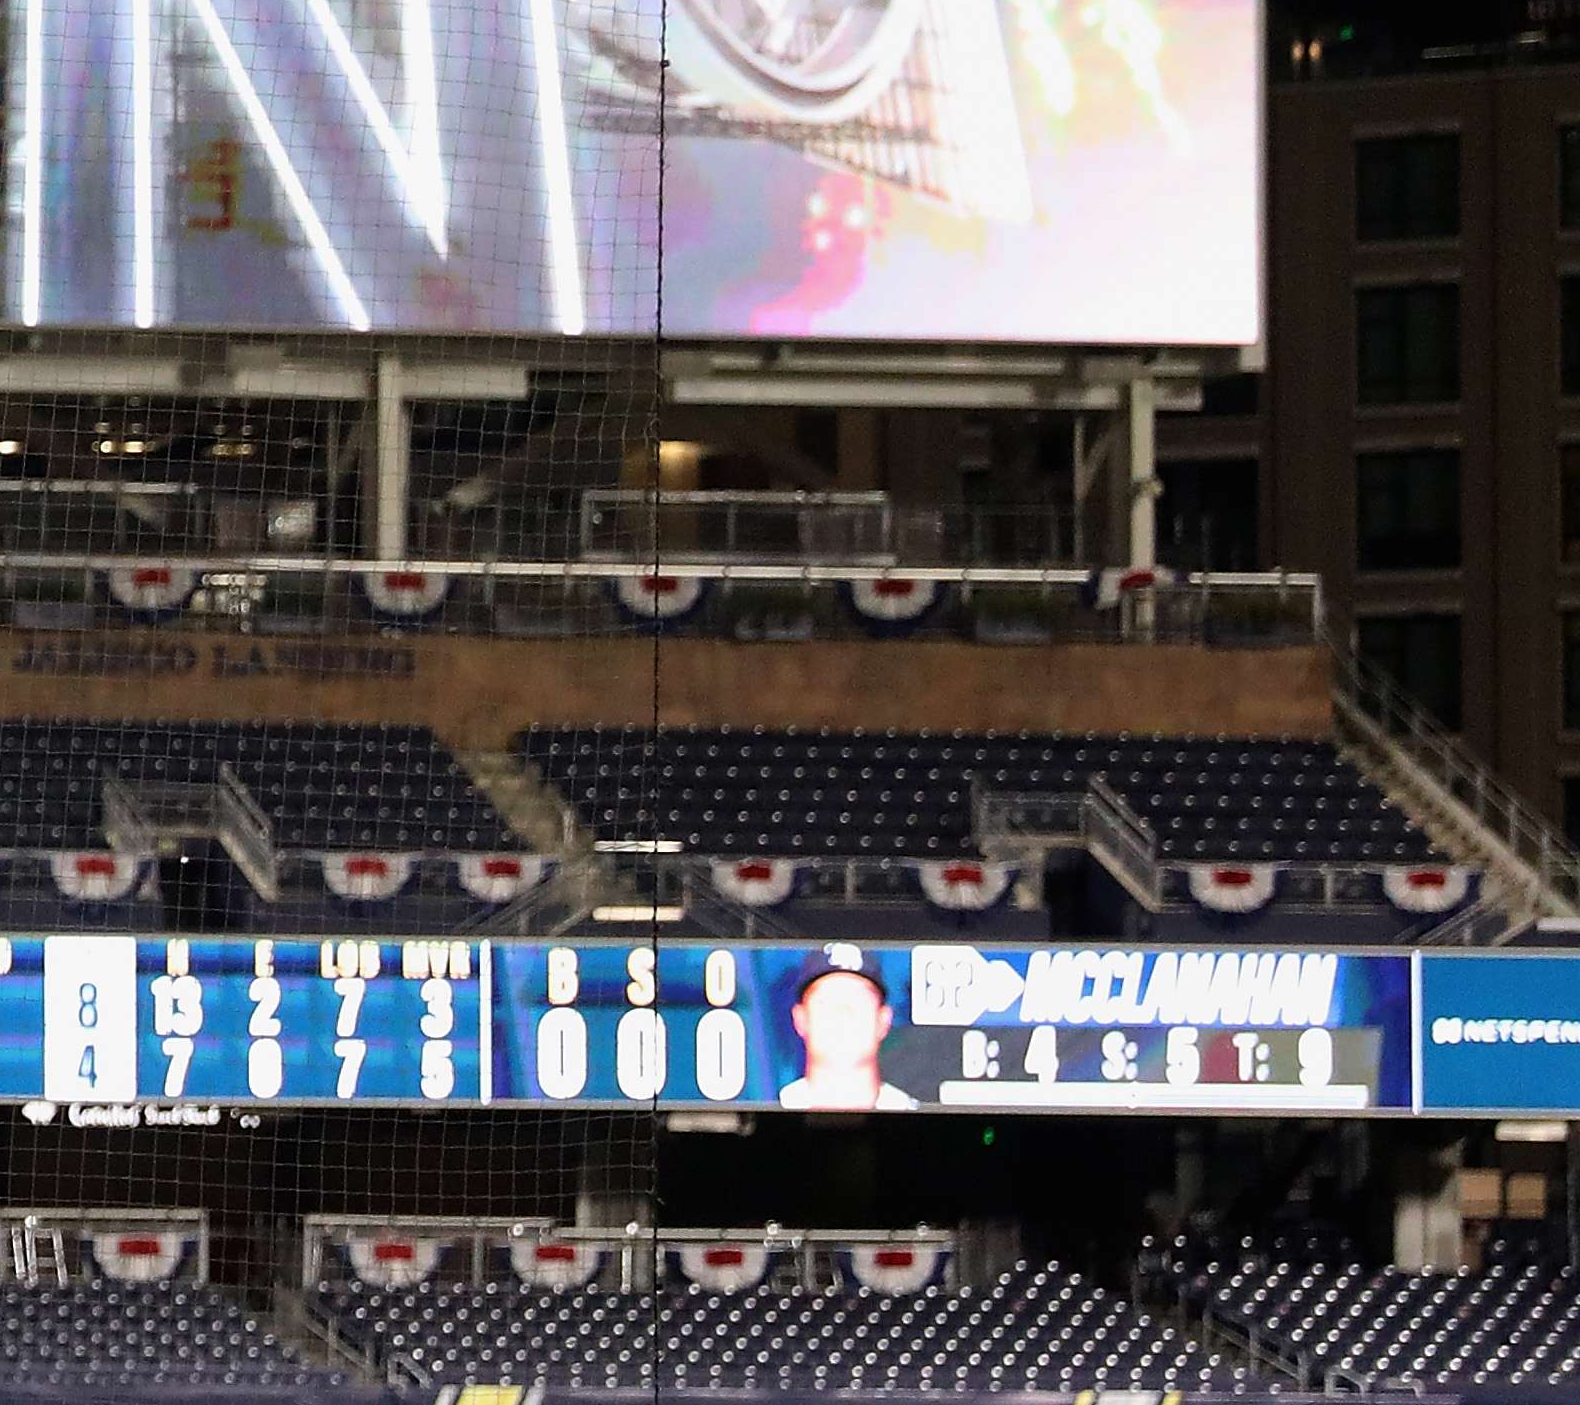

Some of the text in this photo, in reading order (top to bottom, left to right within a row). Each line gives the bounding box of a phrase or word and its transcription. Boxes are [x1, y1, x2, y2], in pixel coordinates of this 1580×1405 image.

[548, 947, 578, 1005] B
[626, 948, 657, 1004] S
[78, 982, 97, 1029] 8
[249, 977, 281, 1037] 2
[334, 978, 365, 1037] 7
[420, 978, 454, 1038] 3
[162, 1039, 194, 1098] 7
[248, 1038, 282, 1099] 0
[334, 1039, 366, 1099] 7
[420, 1039, 454, 1100] 5
[537, 1007, 745, 1101] 0 0 0
[1024, 1025, 1058, 1084] 4
[1165, 1026, 1199, 1086] 5
[1298, 1027, 1333, 1087] 9
